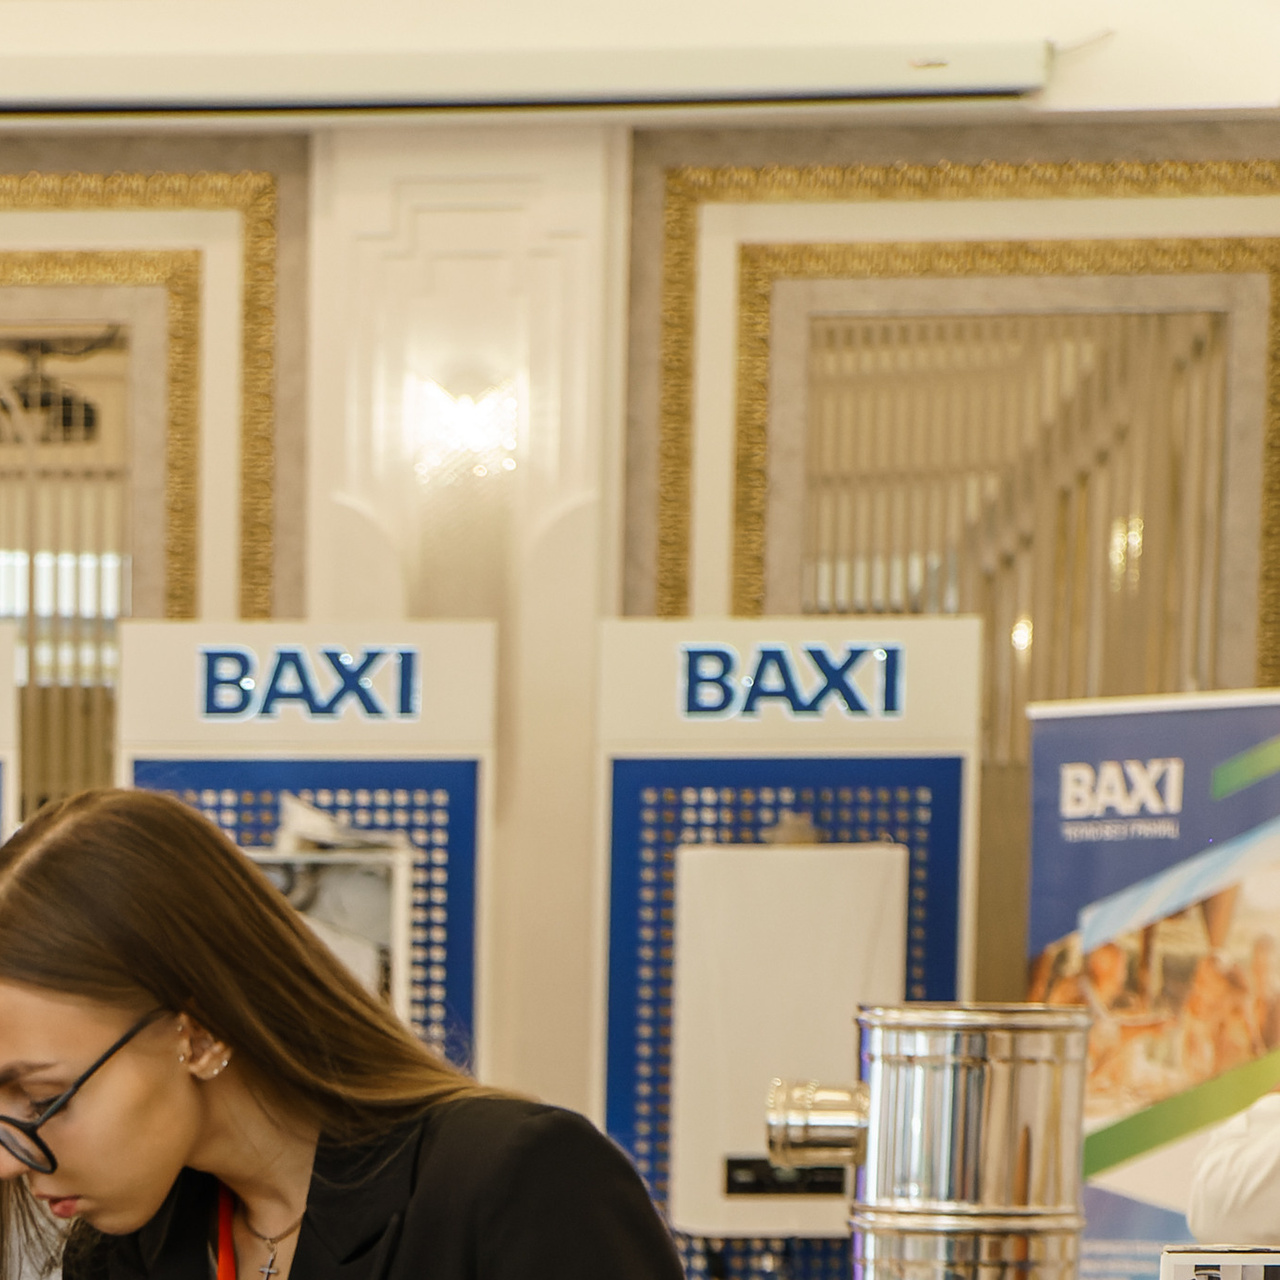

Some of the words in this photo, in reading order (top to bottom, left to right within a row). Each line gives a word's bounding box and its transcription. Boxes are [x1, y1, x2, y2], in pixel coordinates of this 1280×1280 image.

[200, 646, 420, 720] BAXI
[683, 643, 904, 717] BAXI
[1060, 757, 1184, 818] BAXI
